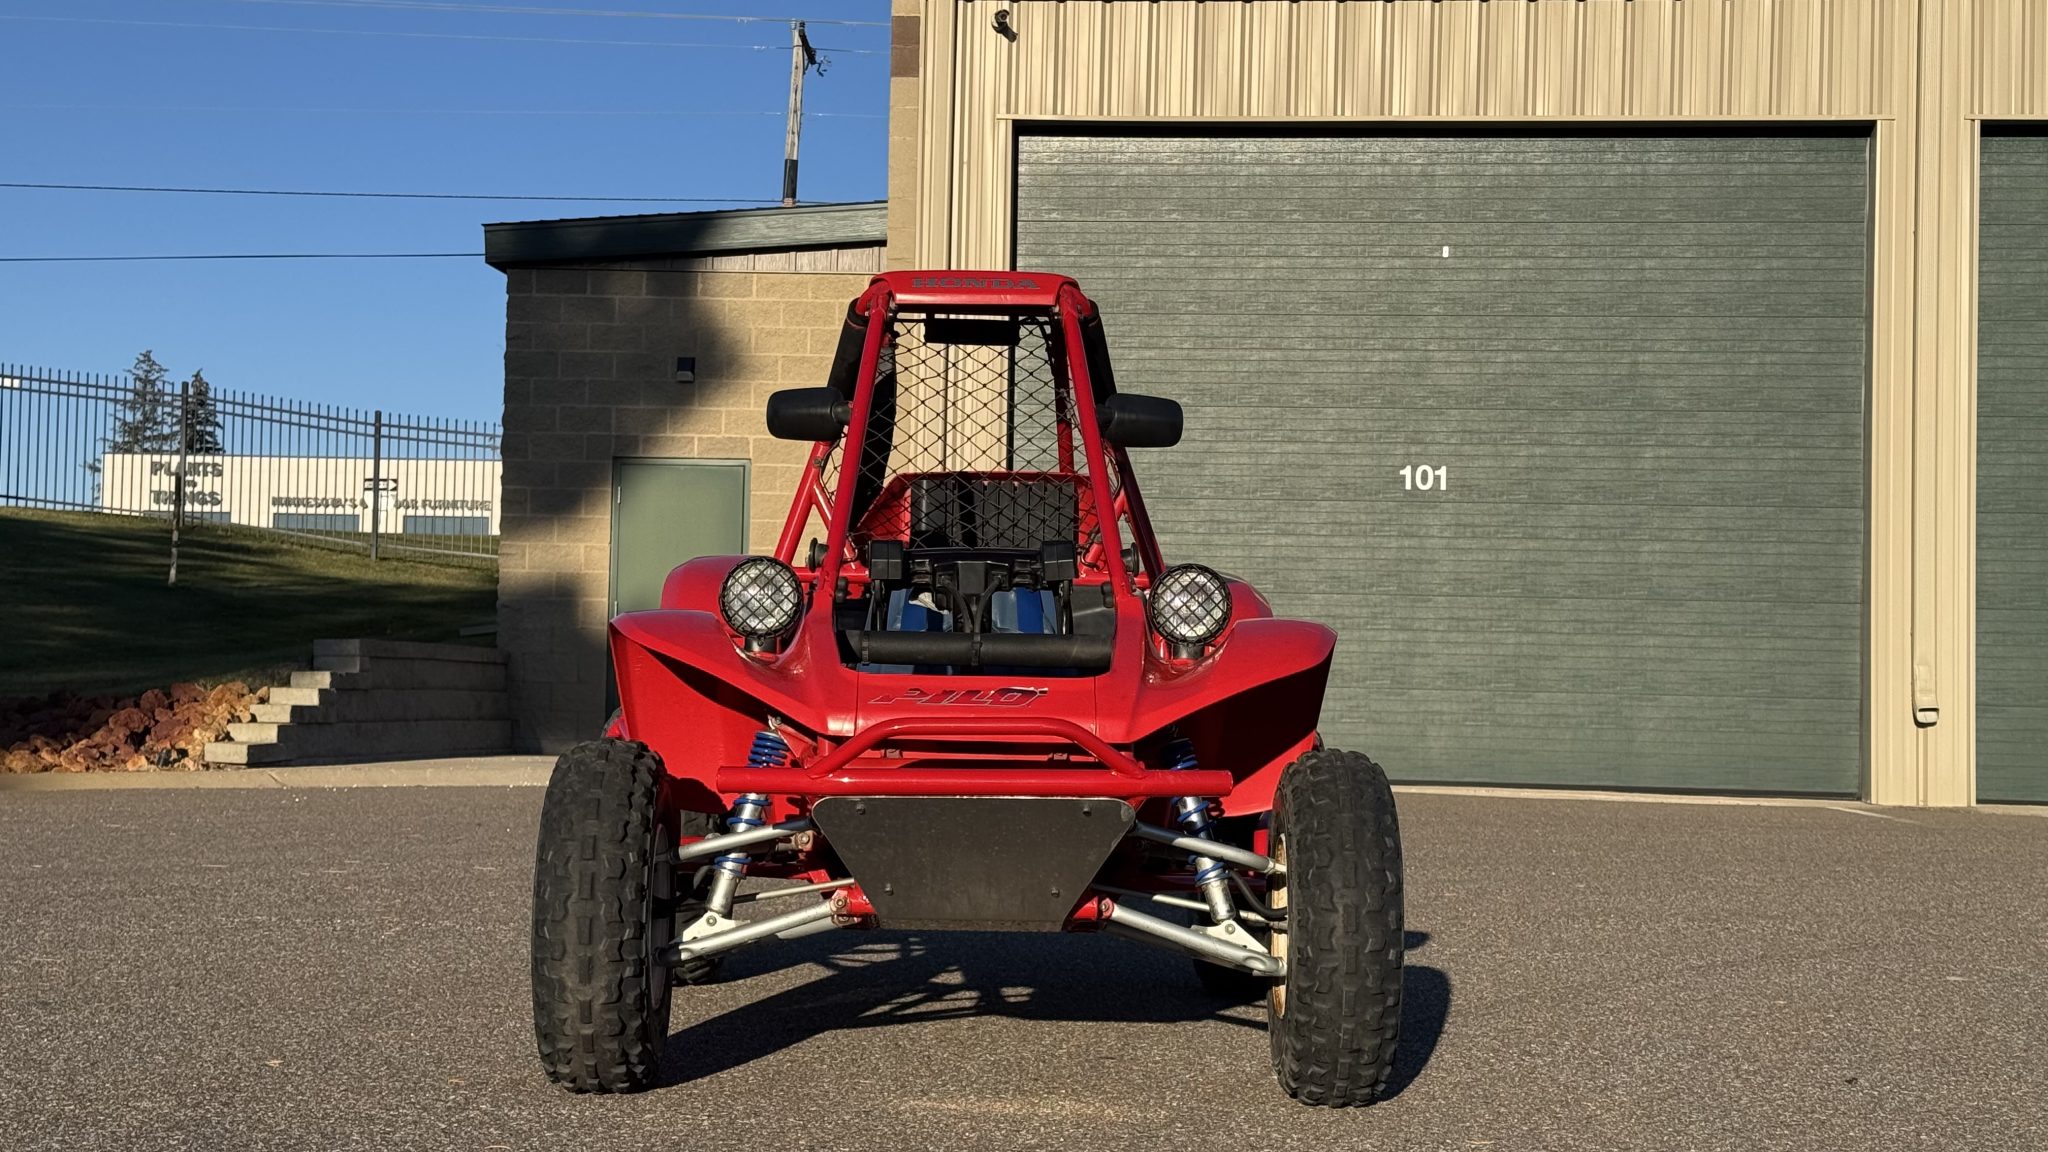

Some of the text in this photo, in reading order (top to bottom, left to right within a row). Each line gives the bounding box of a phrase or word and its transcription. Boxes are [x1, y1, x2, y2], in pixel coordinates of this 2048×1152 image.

[912, 278, 1040, 289] HONDA
[1400, 465, 1446, 490] 101
[151, 491, 222, 506] THNGS
